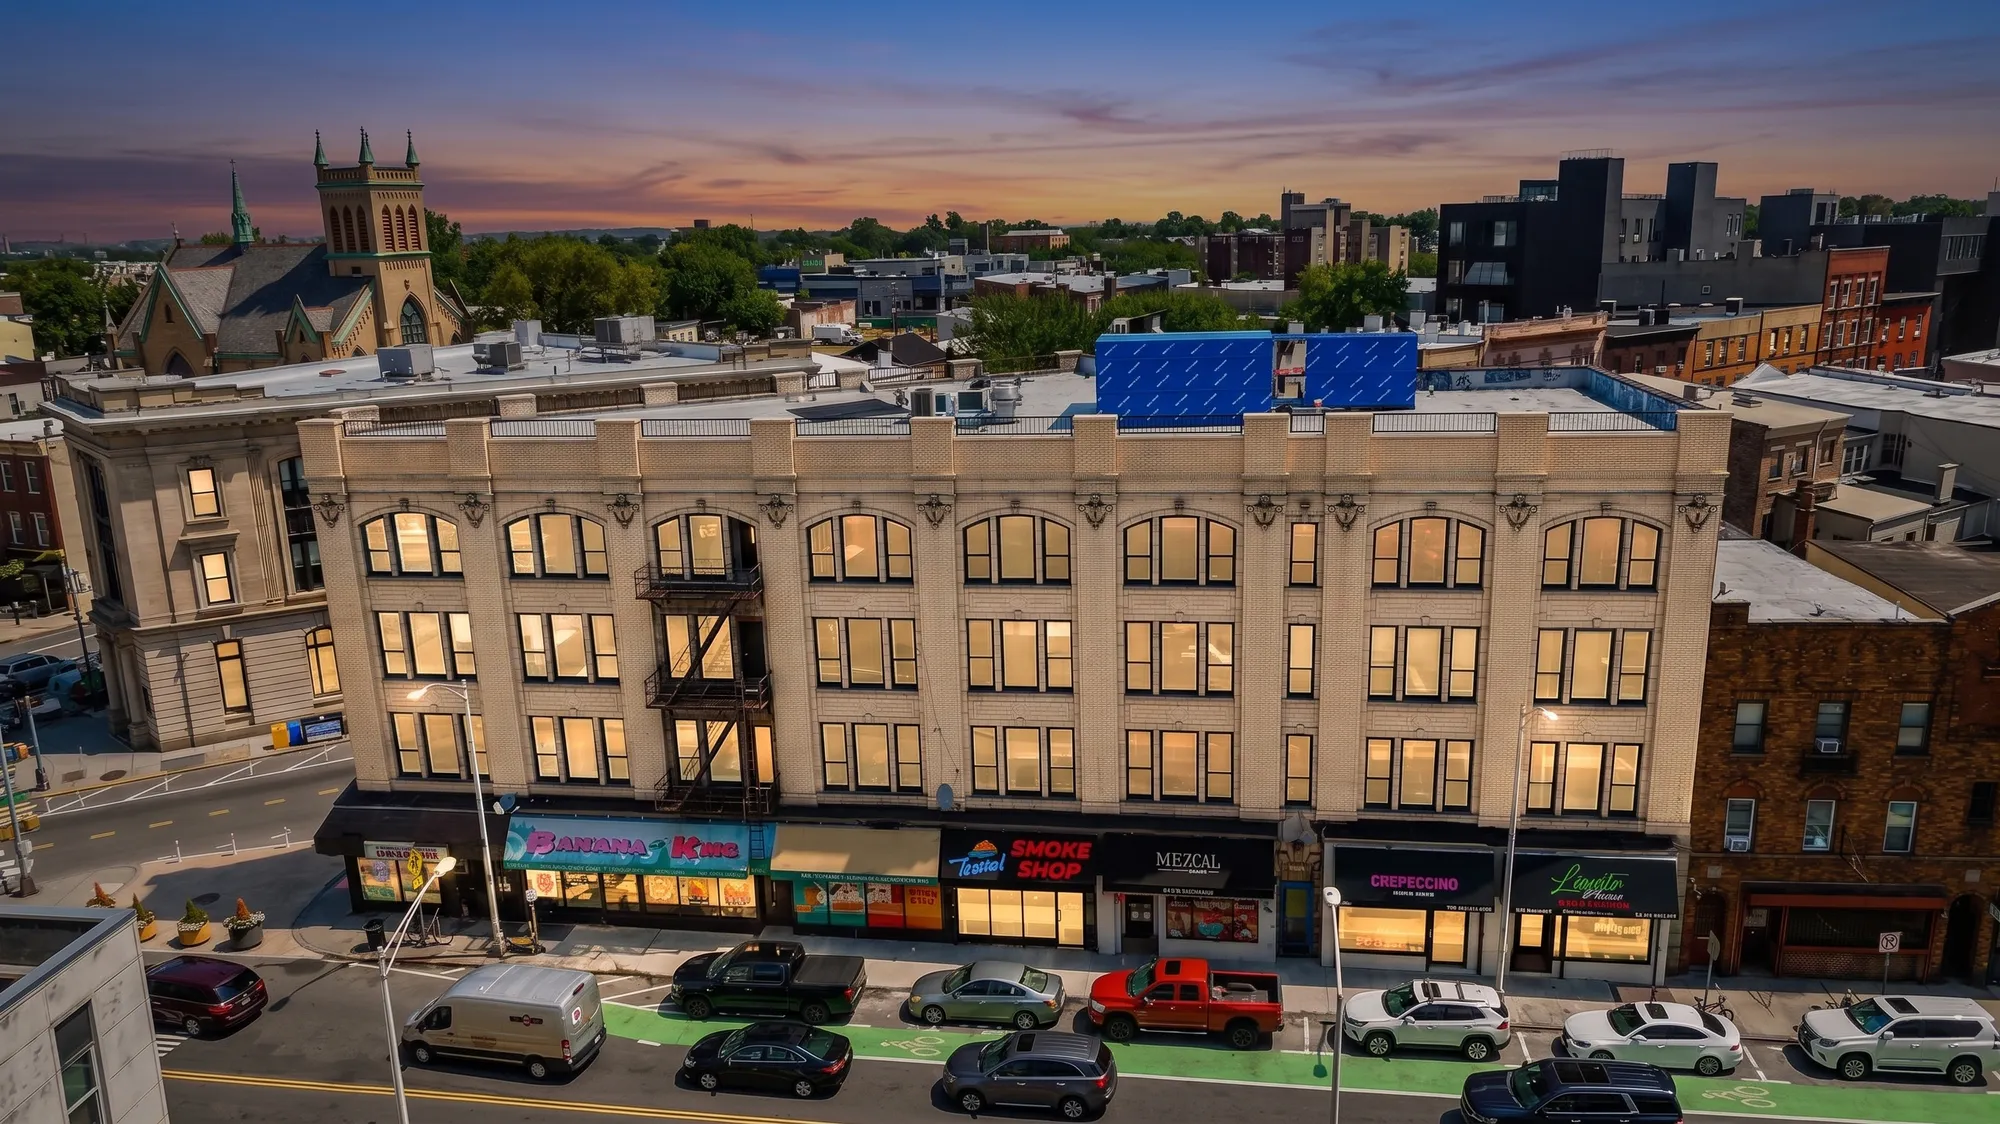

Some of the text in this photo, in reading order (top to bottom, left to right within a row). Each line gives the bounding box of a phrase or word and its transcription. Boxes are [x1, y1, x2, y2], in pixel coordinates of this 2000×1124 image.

[526, 831, 647, 856] BANANA
[1010, 840, 1092, 859] SMOKE
[1156, 852, 1221, 869] MEZCAL
[1017, 861, 1082, 879] SHOP
[1371, 874, 1459, 891] CREPECCINO
